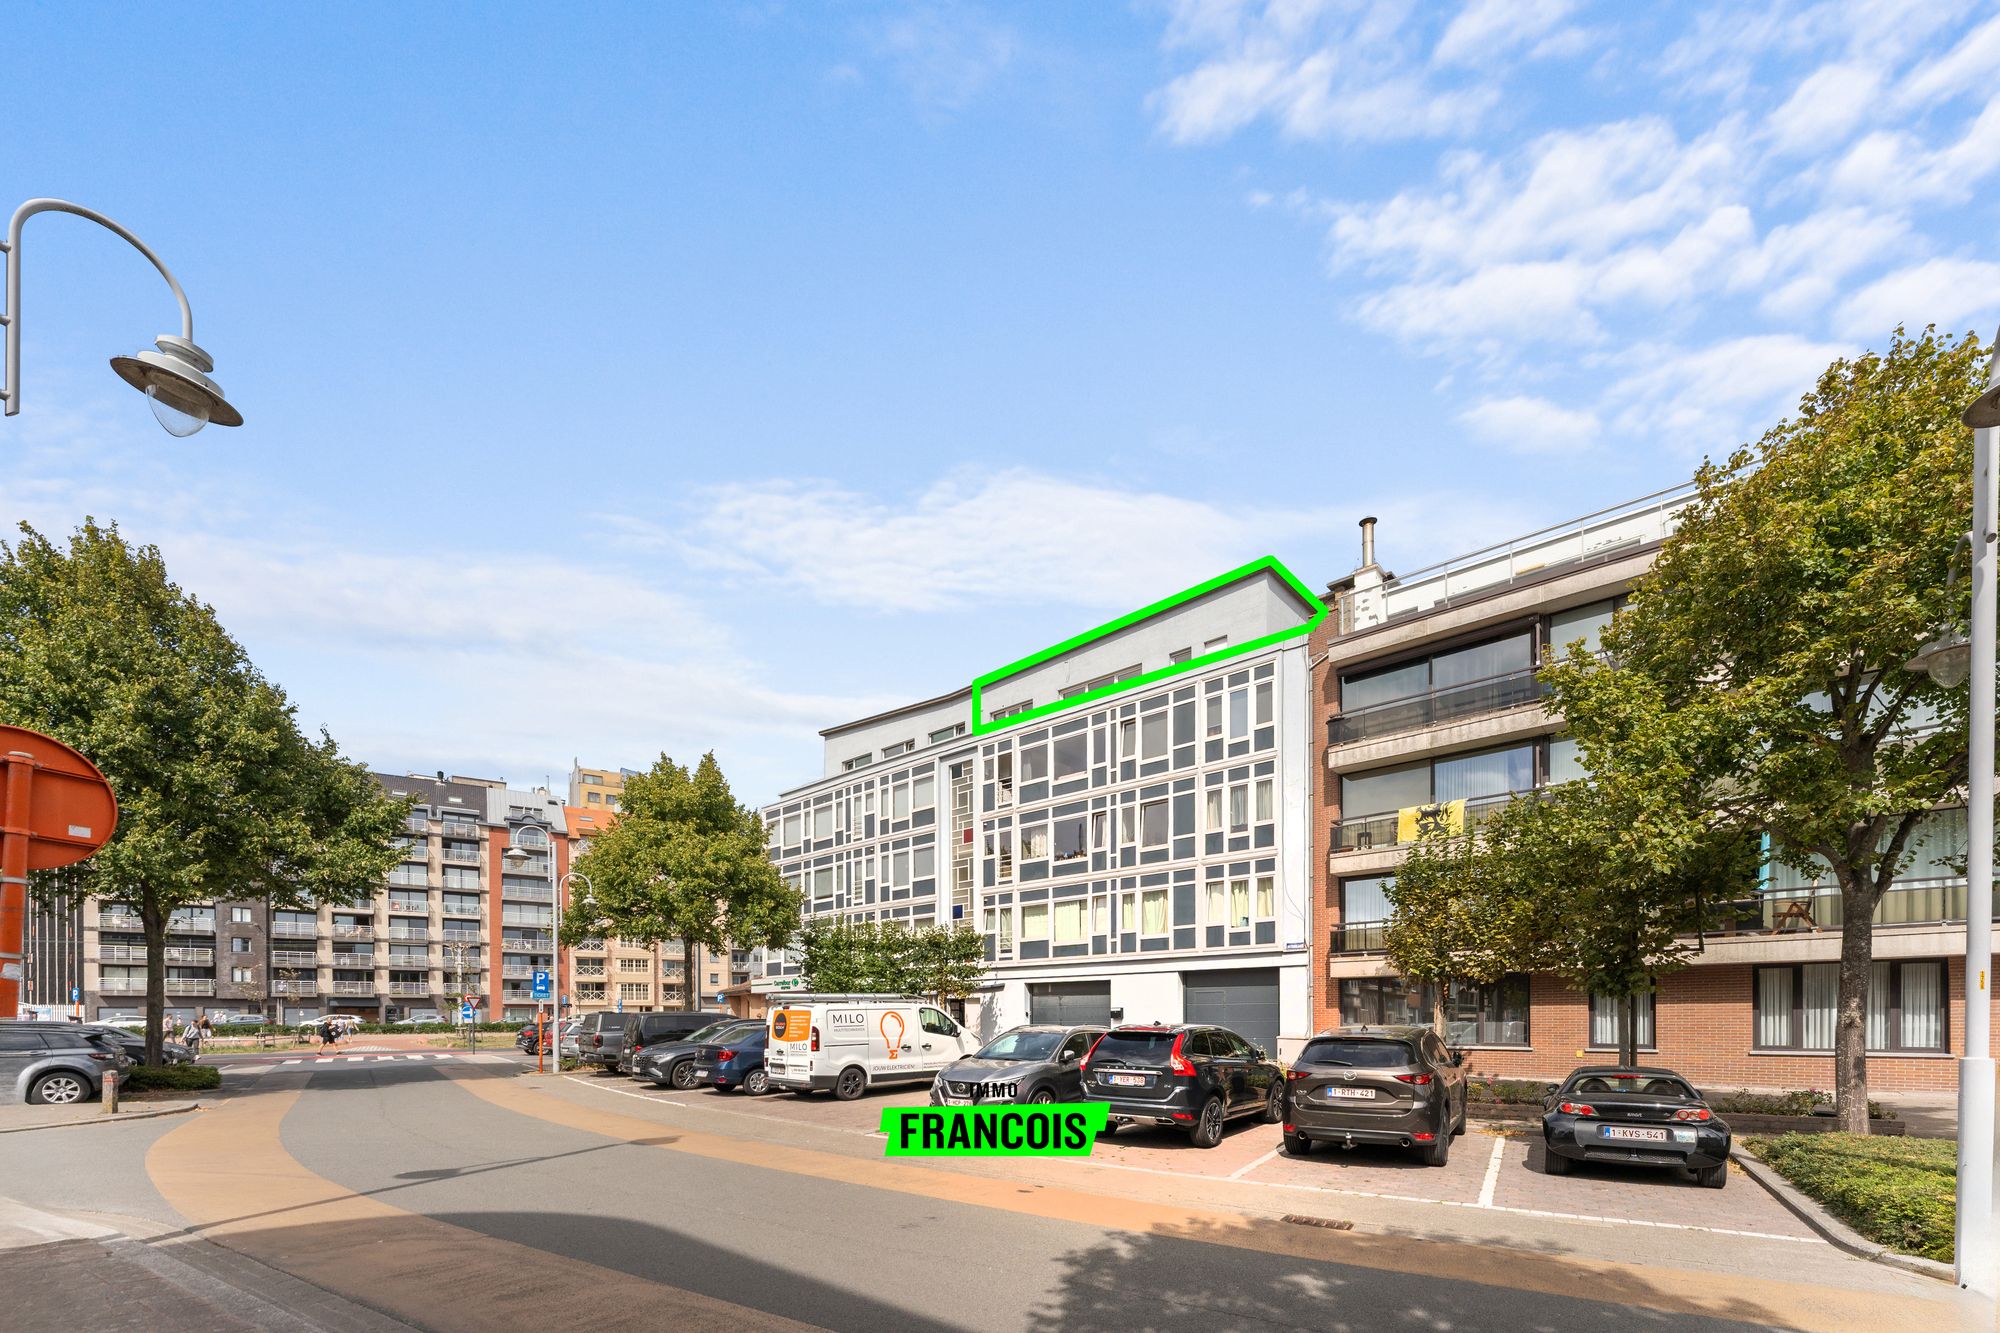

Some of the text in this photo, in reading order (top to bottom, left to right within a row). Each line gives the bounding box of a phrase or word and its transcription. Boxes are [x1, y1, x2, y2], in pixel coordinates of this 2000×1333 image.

[536, 972, 546, 984] P
[832, 1013, 865, 1024] MILO
[789, 1043, 808, 1051] MILO
[1333, 1087, 1375, 1097] 1-RTH-421
[1611, 1128, 1665, 1140] 1-KVS-541
